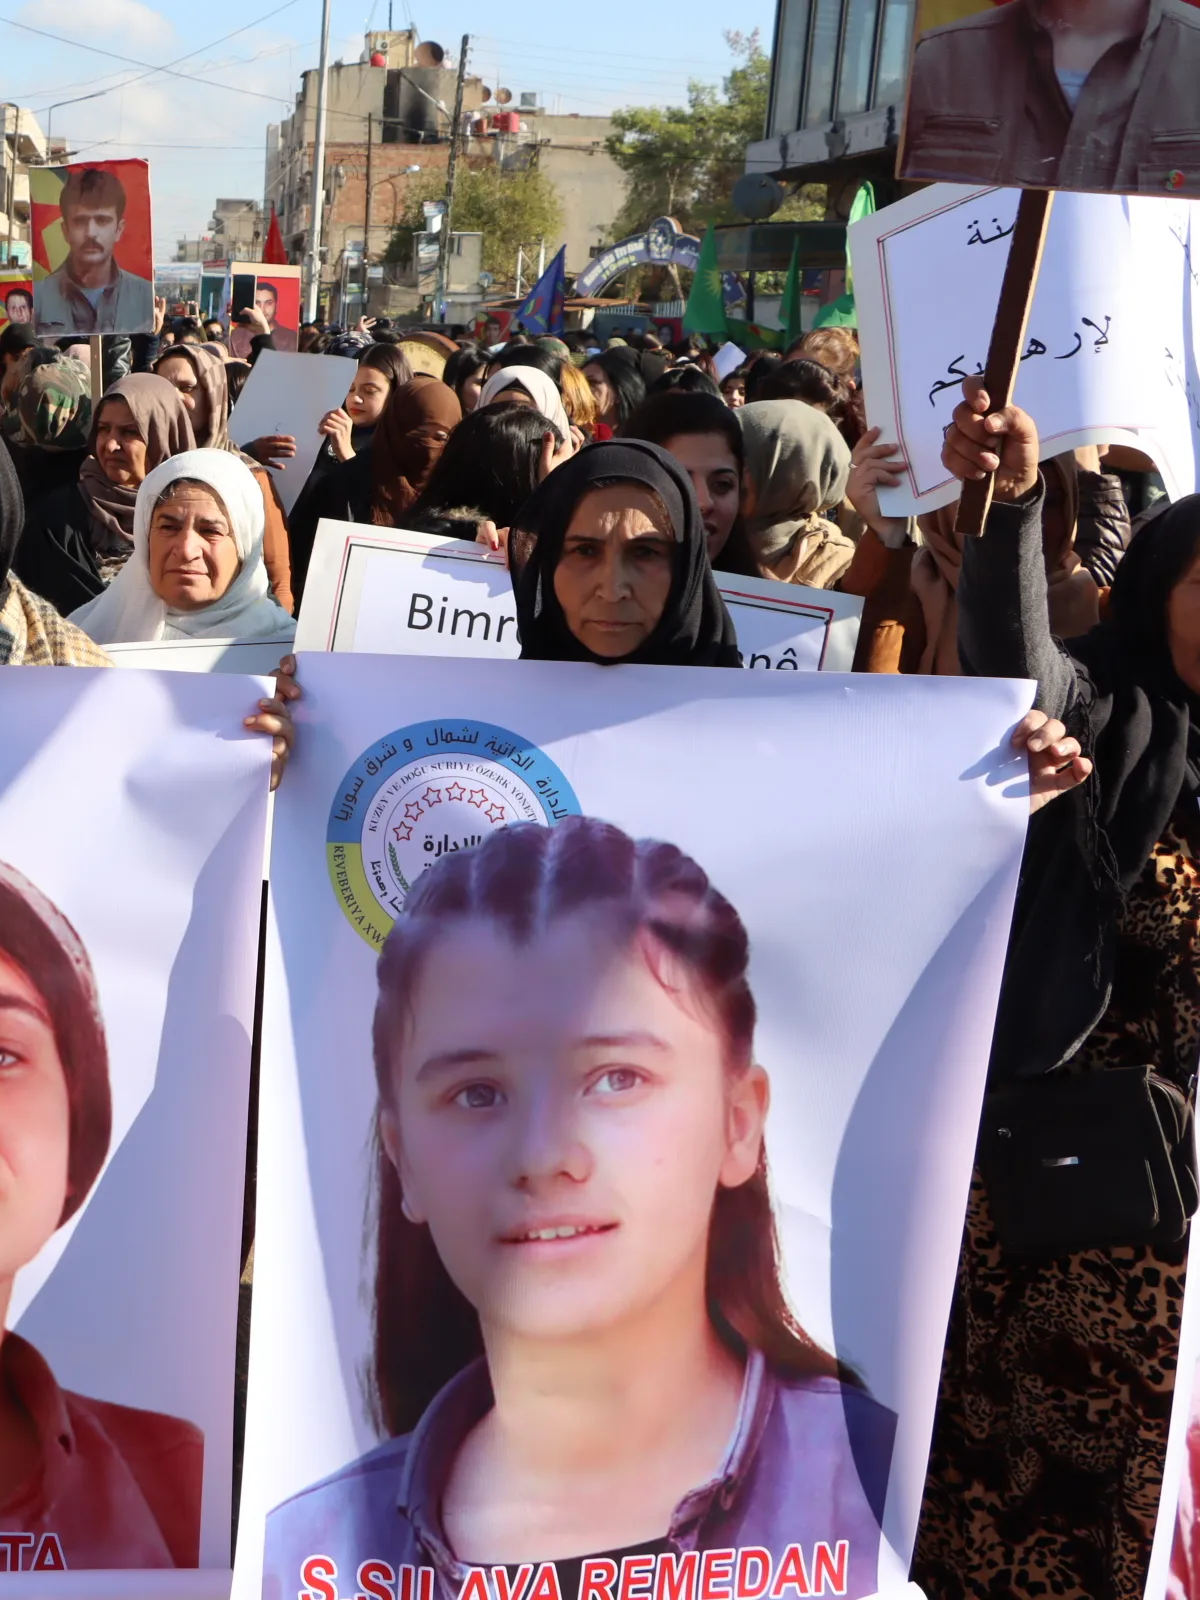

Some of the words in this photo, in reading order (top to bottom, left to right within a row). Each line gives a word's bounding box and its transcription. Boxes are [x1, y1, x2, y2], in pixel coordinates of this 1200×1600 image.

[407, 593, 522, 645] Bimr
[334, 777, 364, 822] سوريا
[368, 797, 389, 832] KUZEY
[387, 781, 402, 797] VE
[333, 844, 366, 925] RÊVEBERIYA
[578, 1540, 850, 1600] REMEDAN
